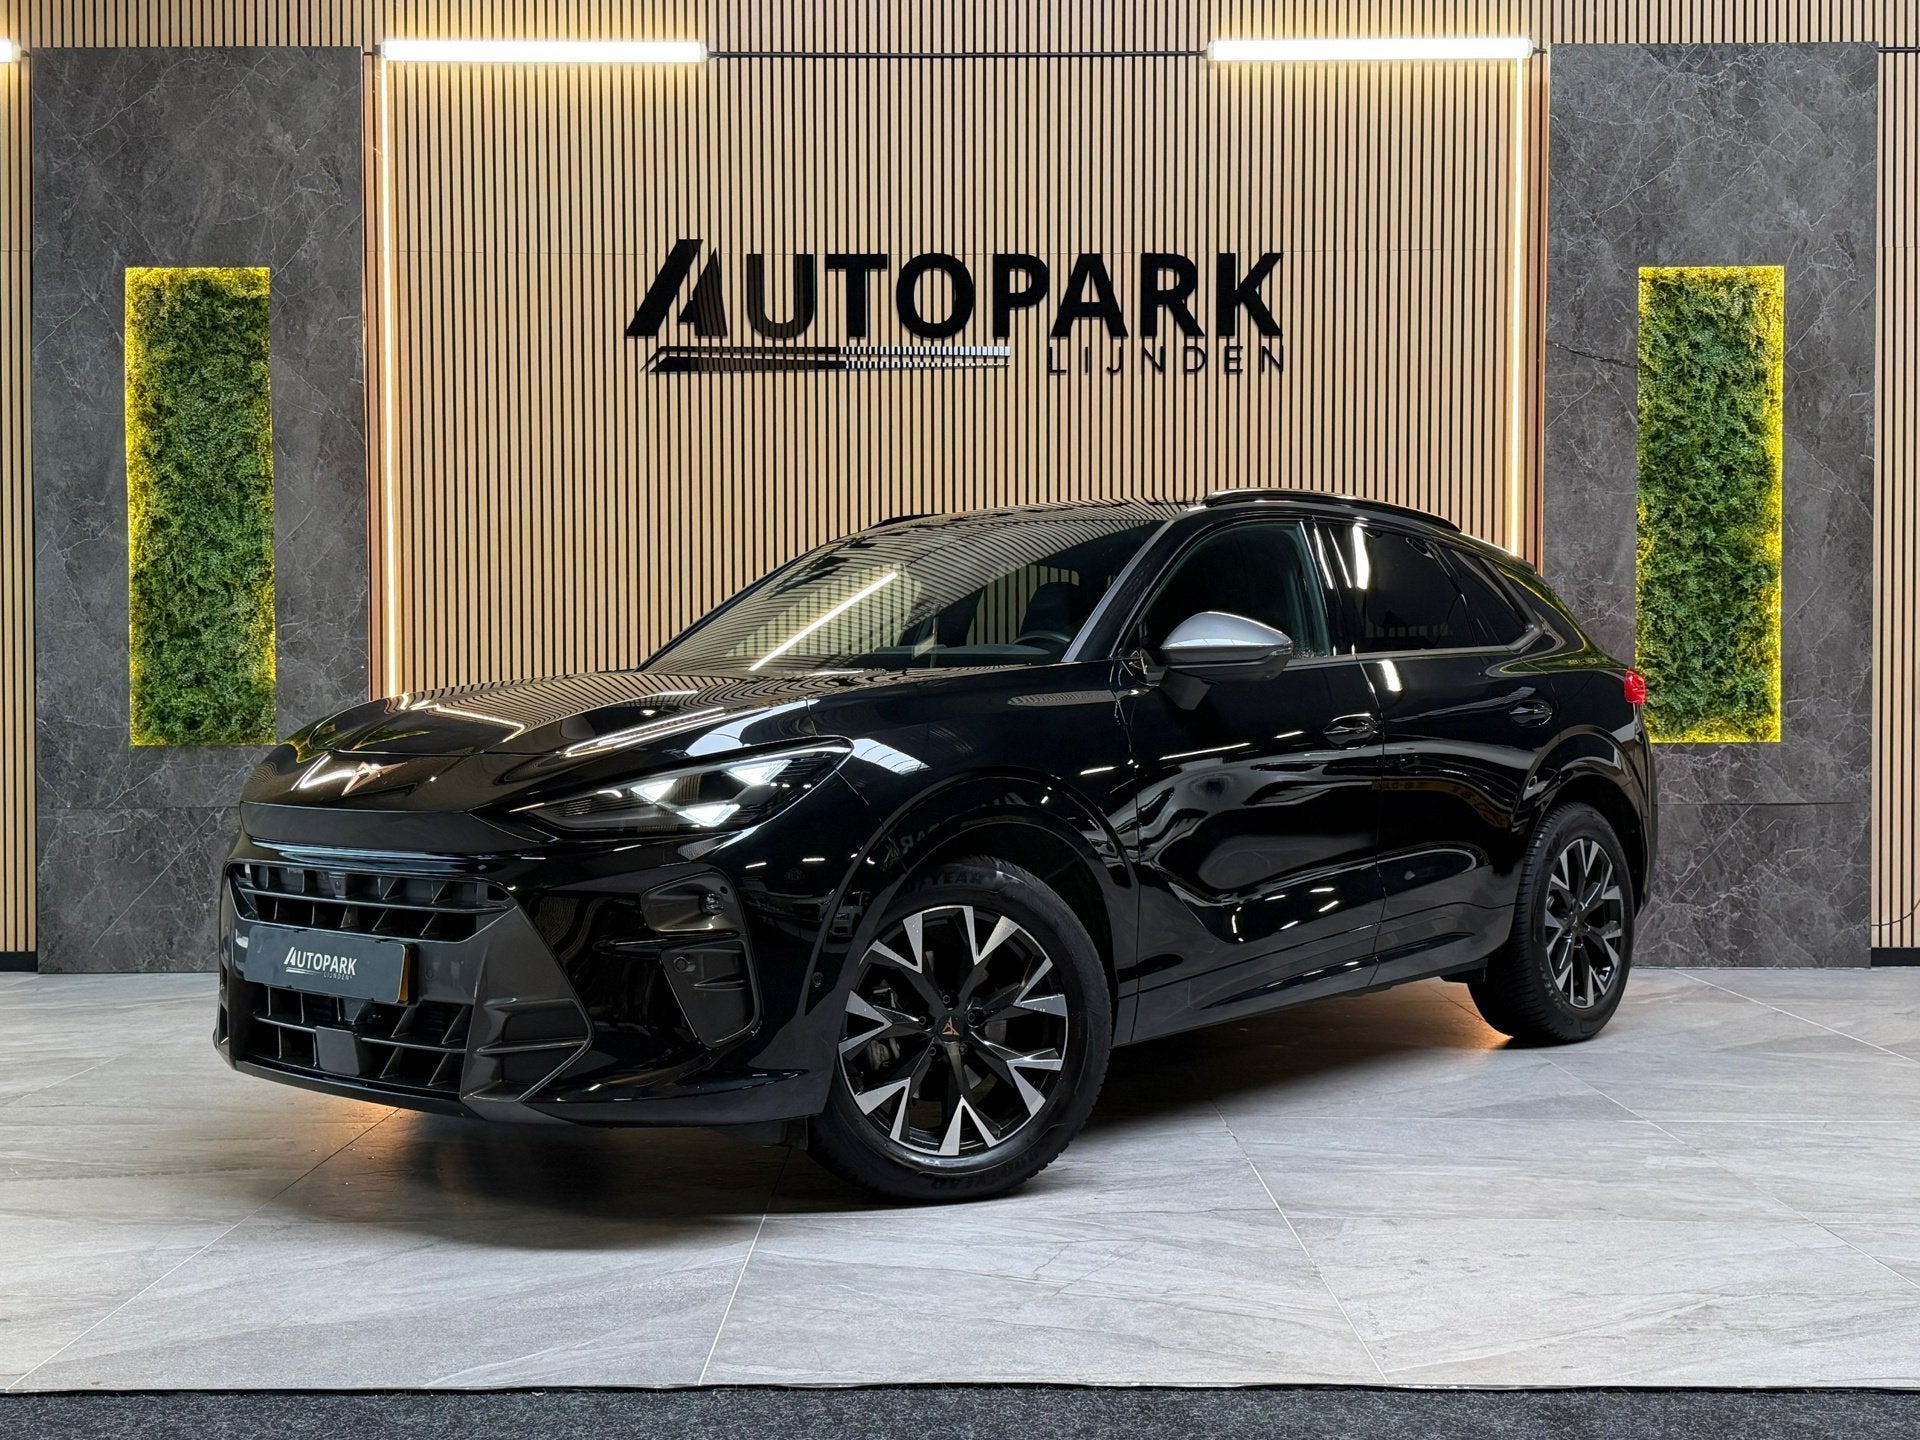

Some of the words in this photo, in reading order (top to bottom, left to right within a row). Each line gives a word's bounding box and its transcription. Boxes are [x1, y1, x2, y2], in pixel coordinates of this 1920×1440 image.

[626, 239, 1283, 338] AUTOPARK
[1049, 346, 1284, 374] LIJNDEN
[283, 946, 358, 976] AUTOPARK
